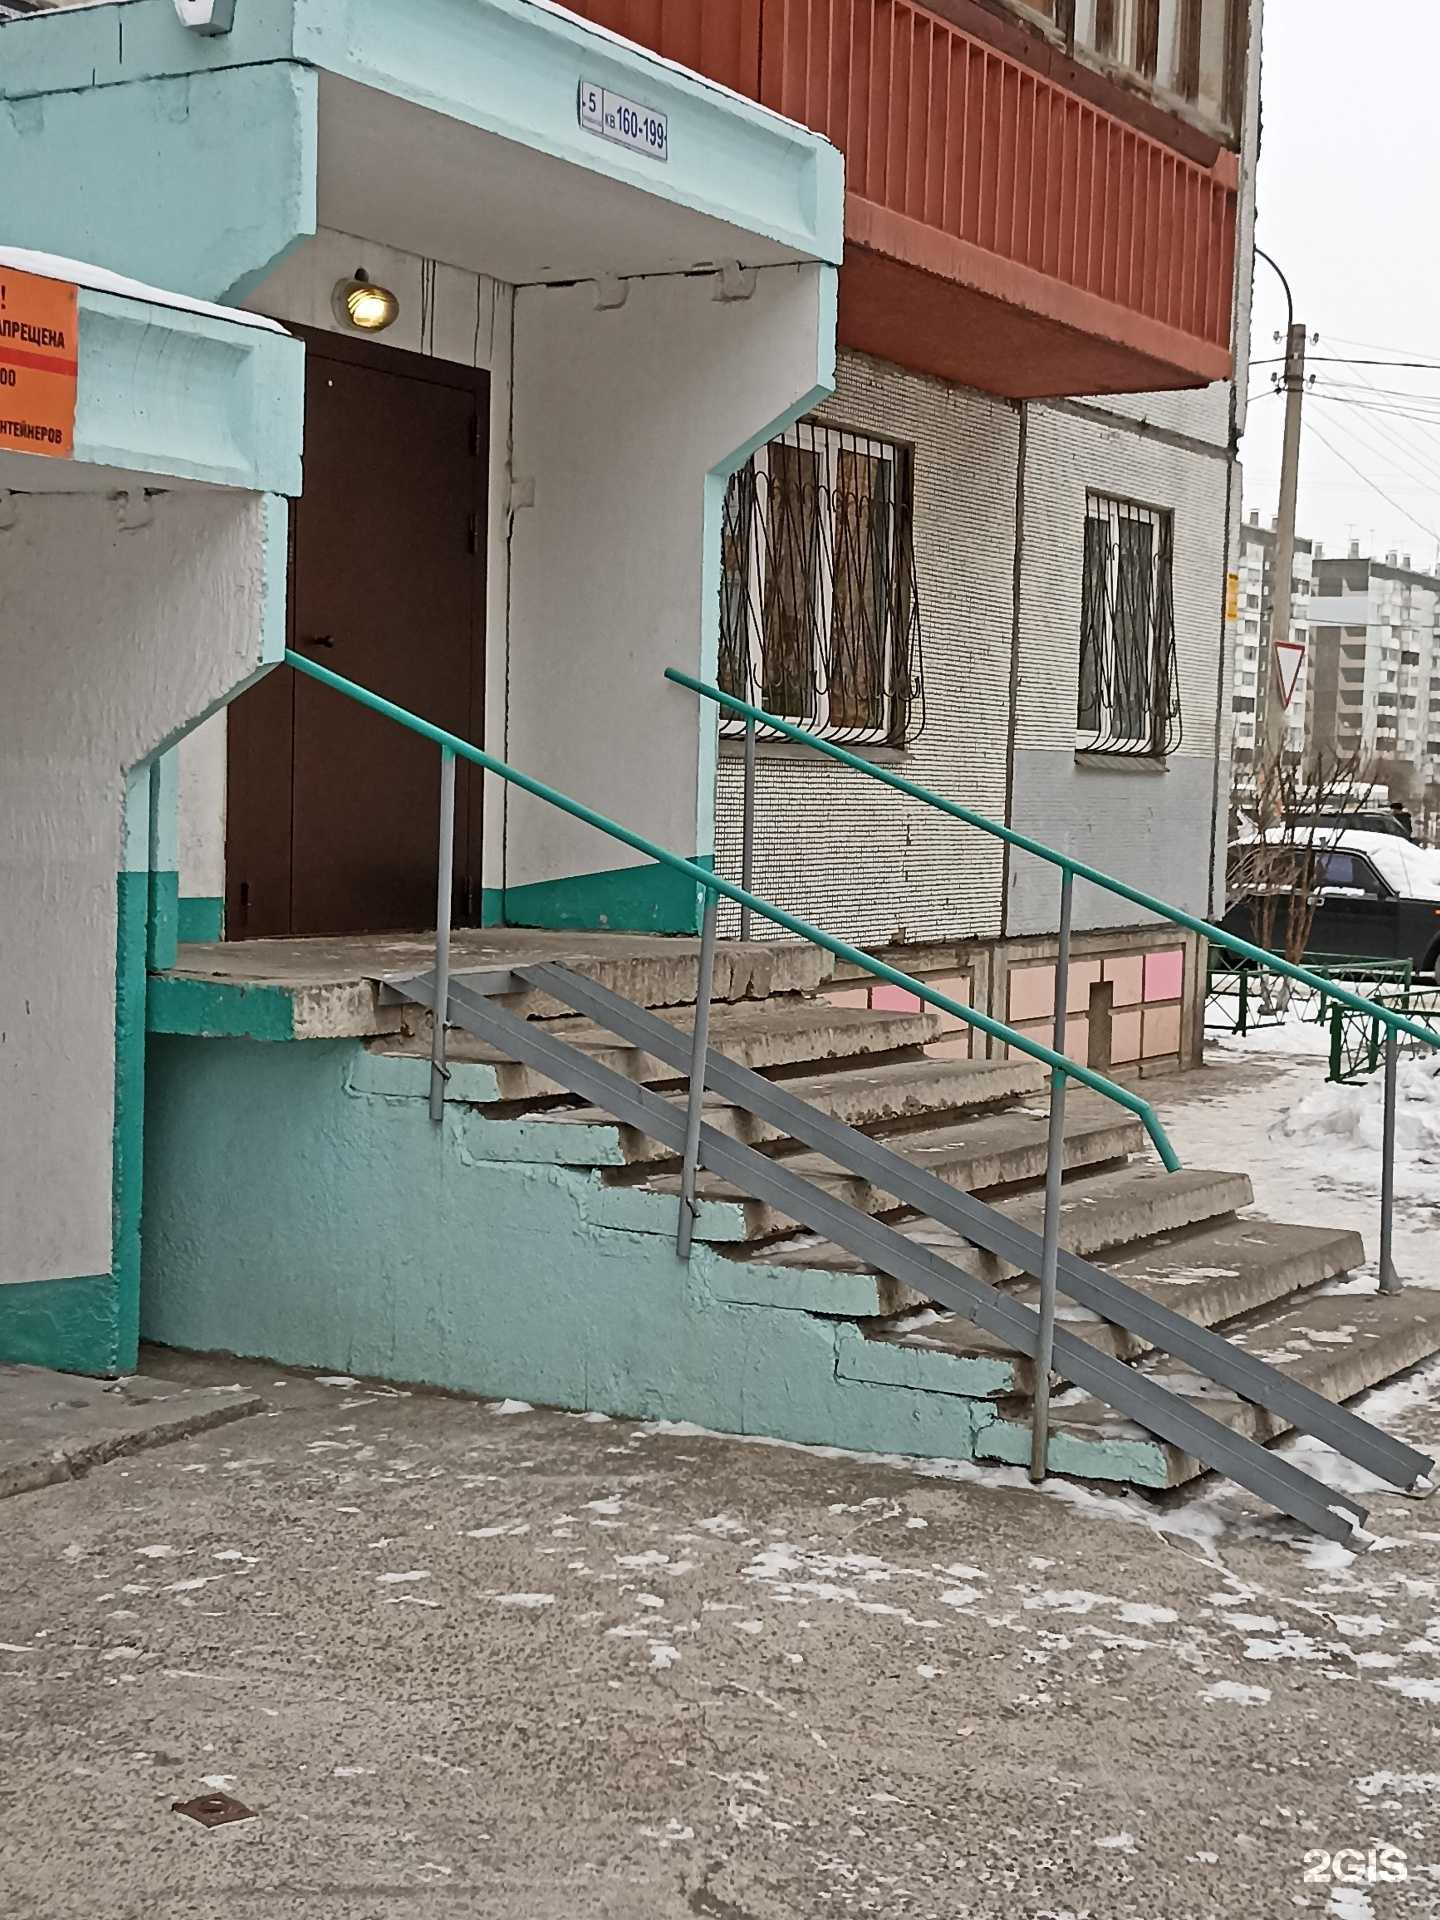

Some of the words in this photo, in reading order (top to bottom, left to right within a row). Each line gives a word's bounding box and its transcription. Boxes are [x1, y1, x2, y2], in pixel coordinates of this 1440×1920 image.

[588, 92, 597, 112] 5
[617, 106, 664, 149] 160-199
[0, 319, 65, 348] ПРЕЩЕНА
